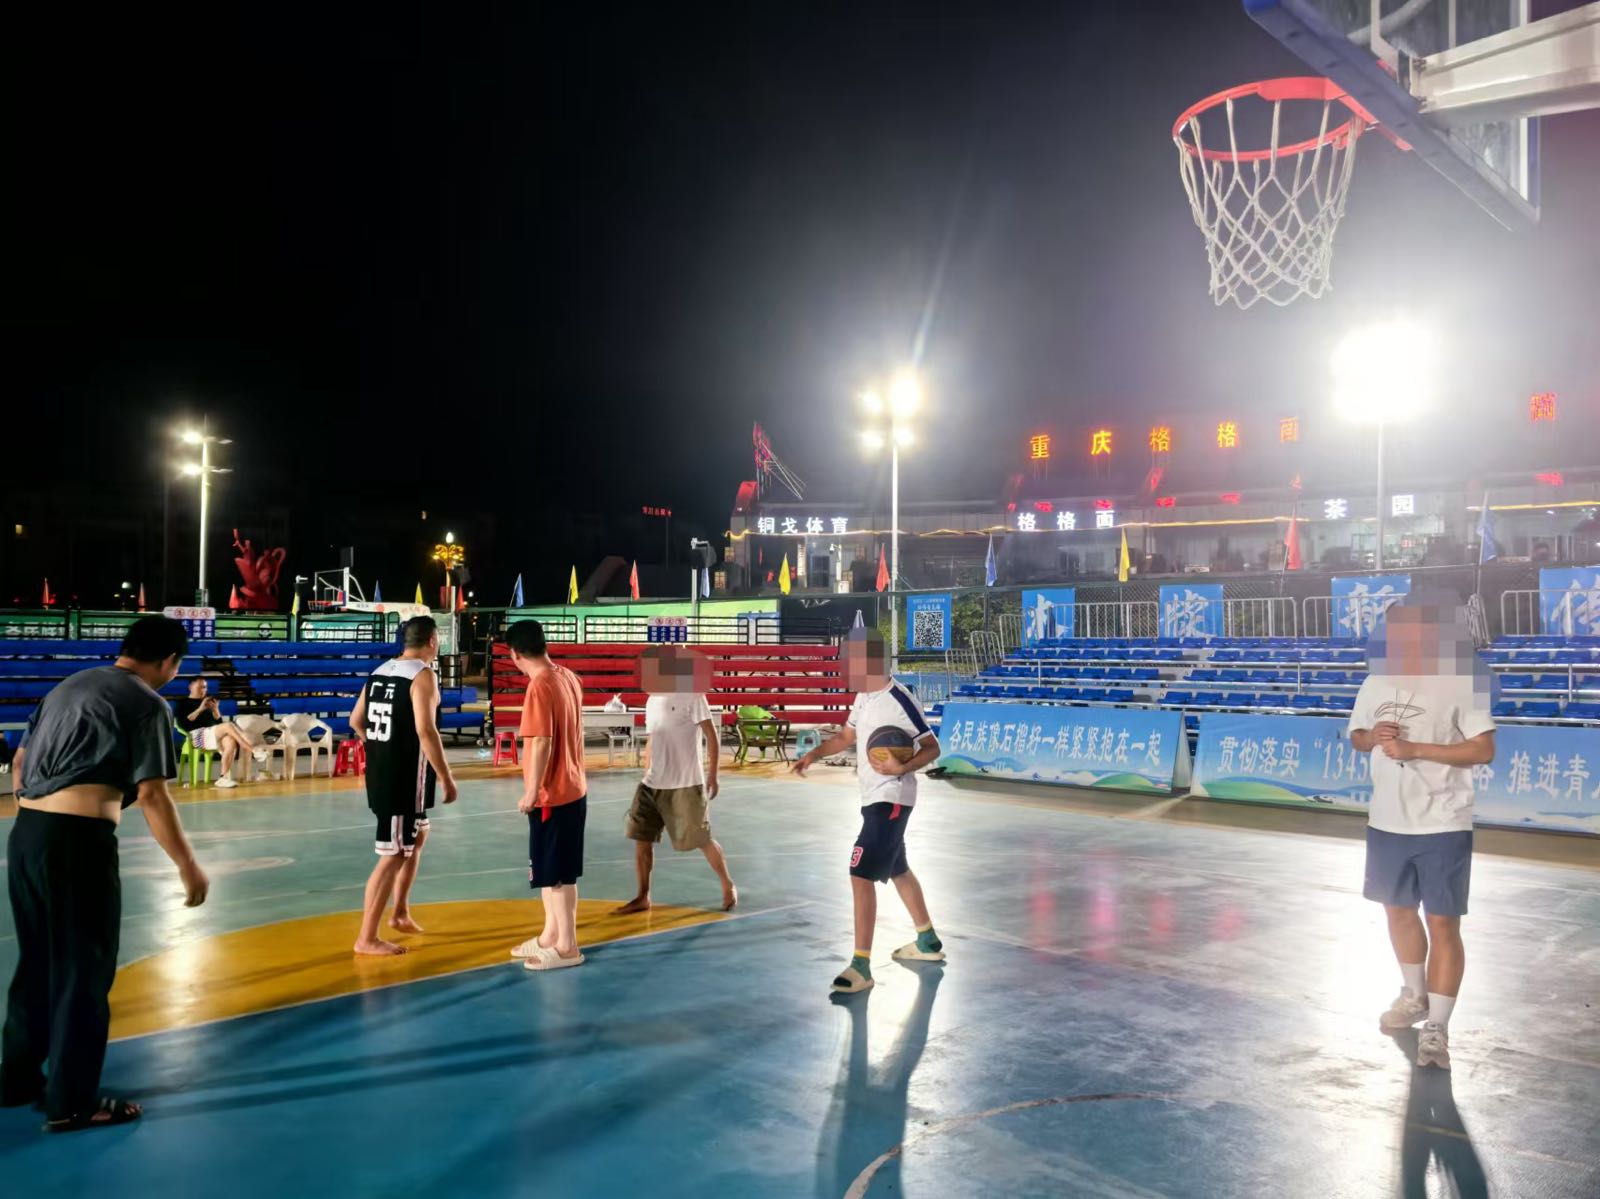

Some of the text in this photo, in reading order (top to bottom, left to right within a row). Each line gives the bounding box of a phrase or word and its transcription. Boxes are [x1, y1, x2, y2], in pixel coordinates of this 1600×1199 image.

[1323, 494, 1415, 520] 茶园
[758, 516, 849, 534] 铜戈体育
[1017, 509, 1116, 532] 格格面
[369, 681, 397, 700] 广元
[366, 701, 393, 742] 55
[949, 719, 1163, 767] 各民族像石榴籽一样紧紧抱在一起
[1217, 735, 1301, 778] 贯彻落实
[1506, 749, 1600, 801] 推进青
